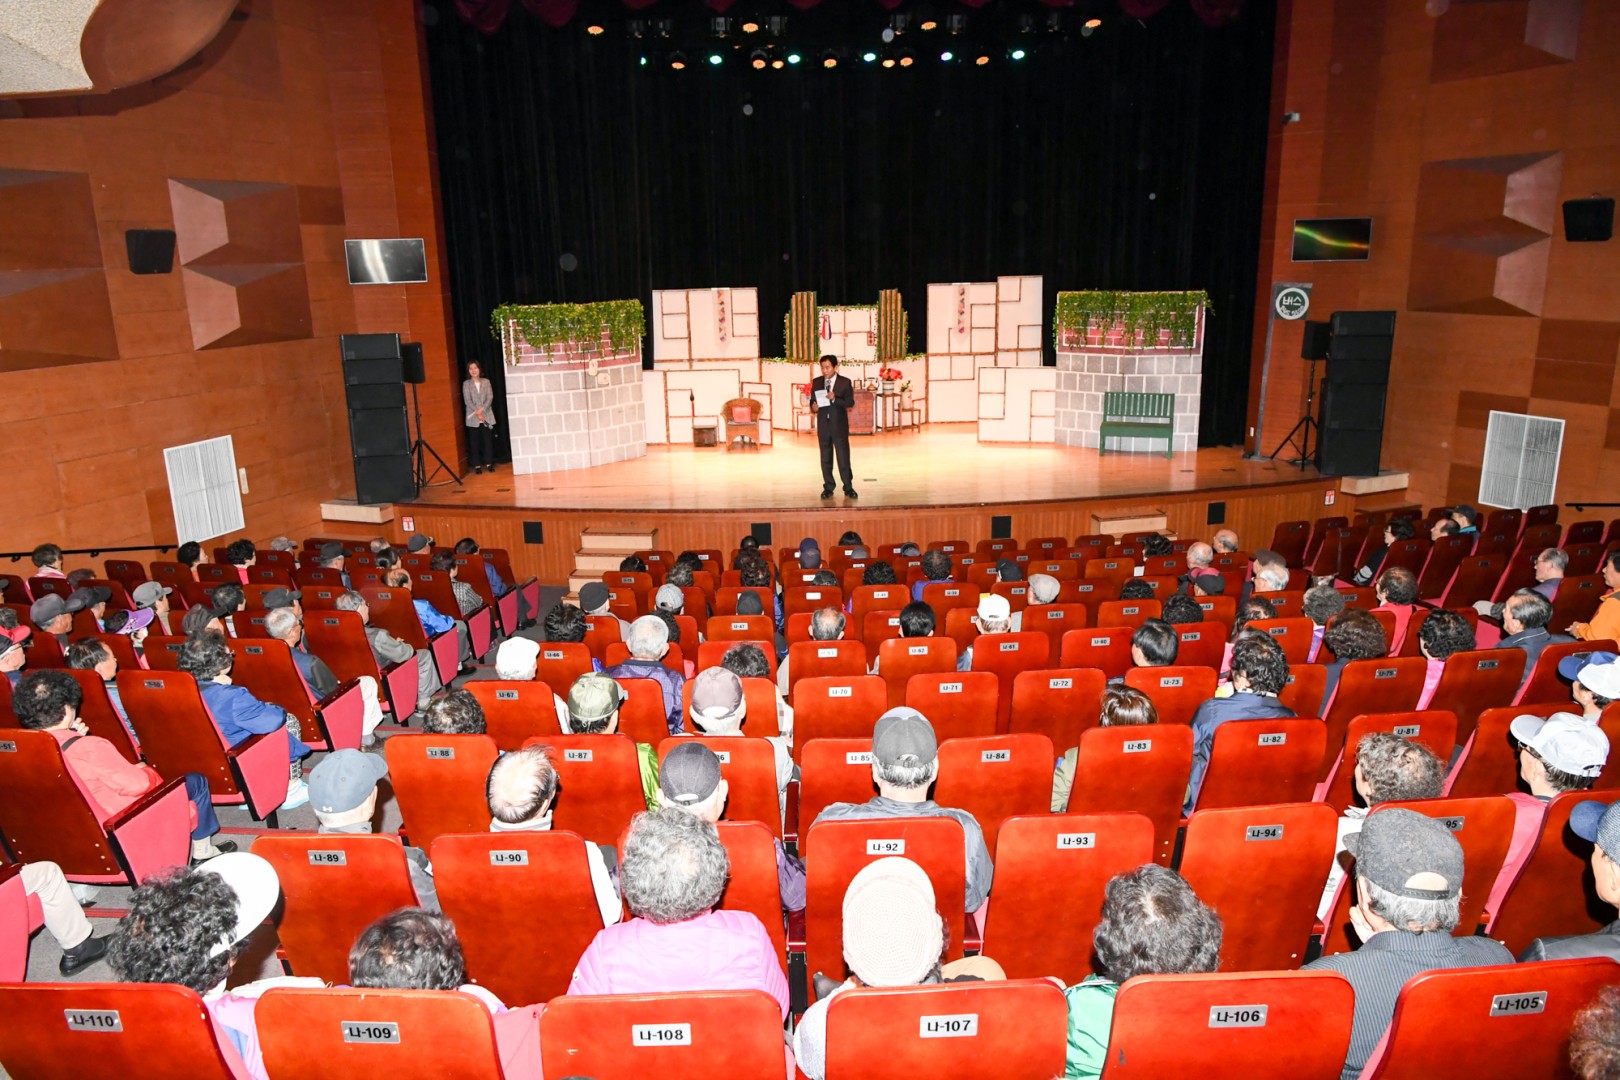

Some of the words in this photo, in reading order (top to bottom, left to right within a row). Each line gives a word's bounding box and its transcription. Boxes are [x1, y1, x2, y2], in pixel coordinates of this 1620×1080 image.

[1283, 296, 1302, 306] 버스
[1446, 820, 1458, 829] 95
[1252, 829, 1276, 837] 나-94
[1063, 837, 1088, 845] 나-93
[873, 843, 898, 851] 나-92
[314, 854, 339, 862] 나-89
[496, 854, 521, 862] 나-90
[1498, 997, 1540, 1010] 나-105
[73, 1015, 115, 1027] 나-110
[1217, 1010, 1260, 1023] 나-106
[928, 1020, 971, 1032] 나-107
[349, 1026, 392, 1039] 나-109
[640, 1029, 683, 1041] 나-108
